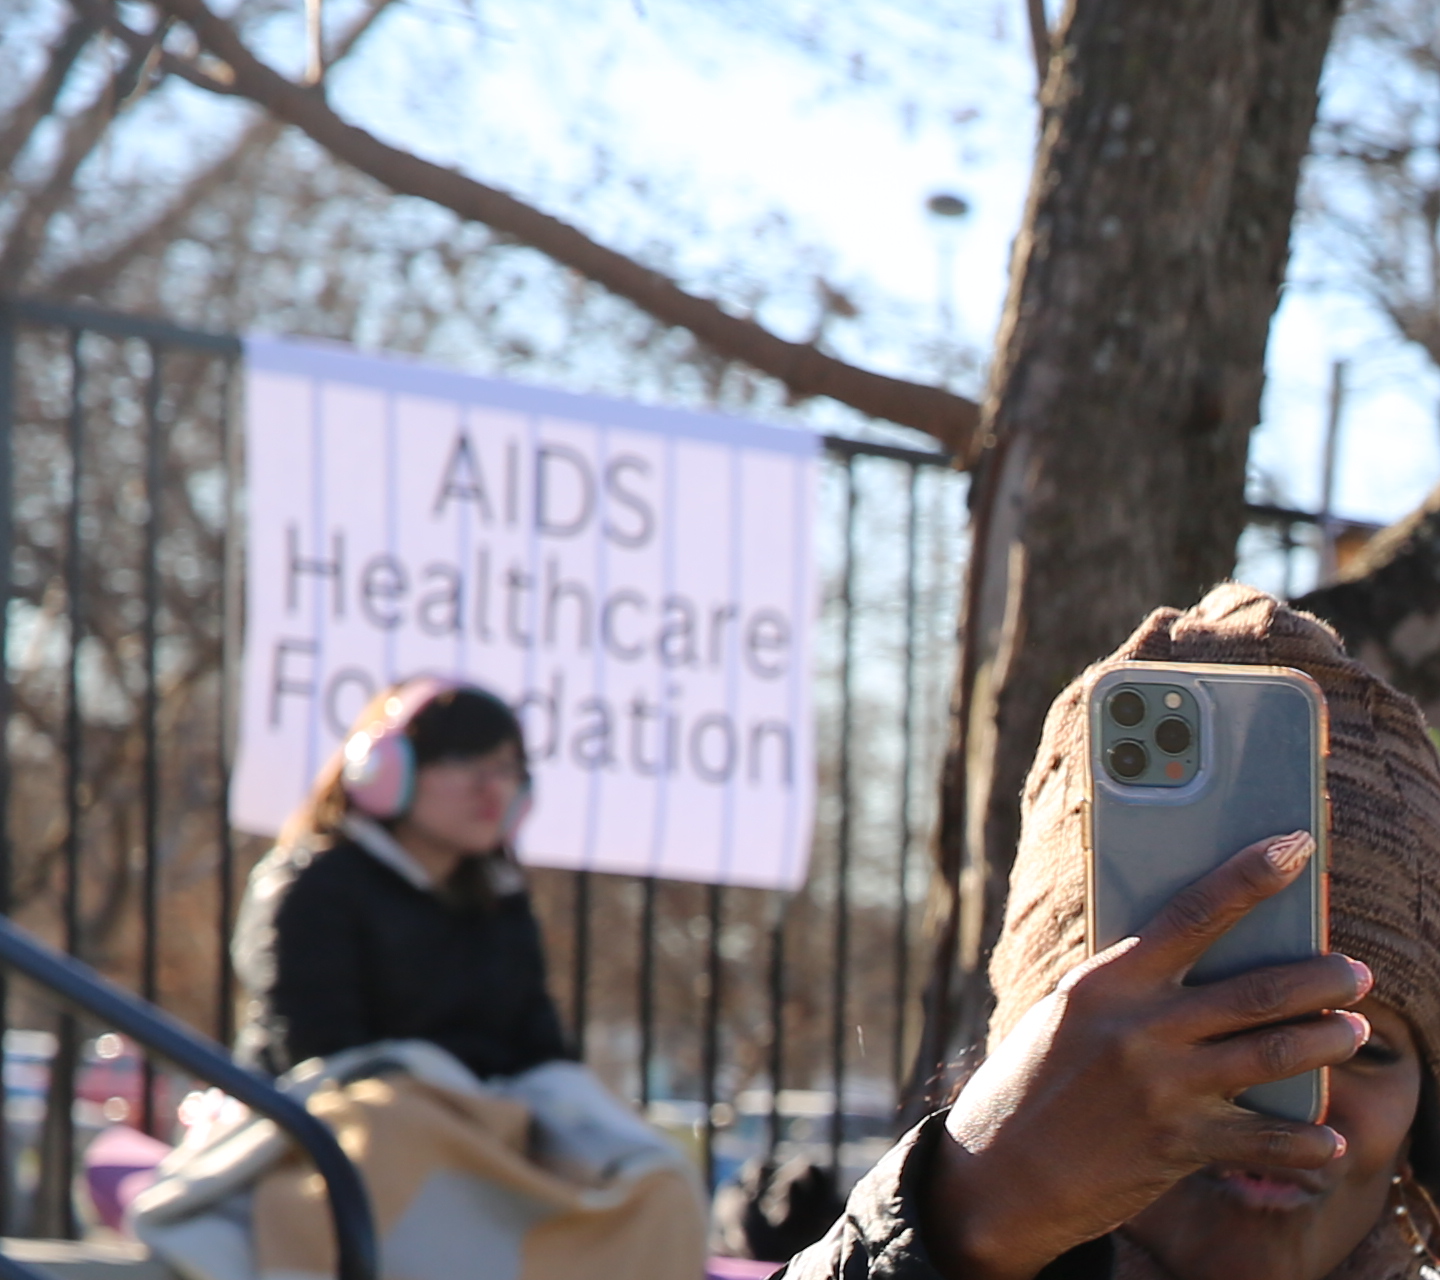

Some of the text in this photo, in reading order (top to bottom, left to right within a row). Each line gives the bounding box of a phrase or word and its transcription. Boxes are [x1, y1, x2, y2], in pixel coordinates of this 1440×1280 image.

[430, 428, 657, 550] AIDS
[283, 519, 793, 682] Healthcare
[266, 635, 796, 789] Fodation
